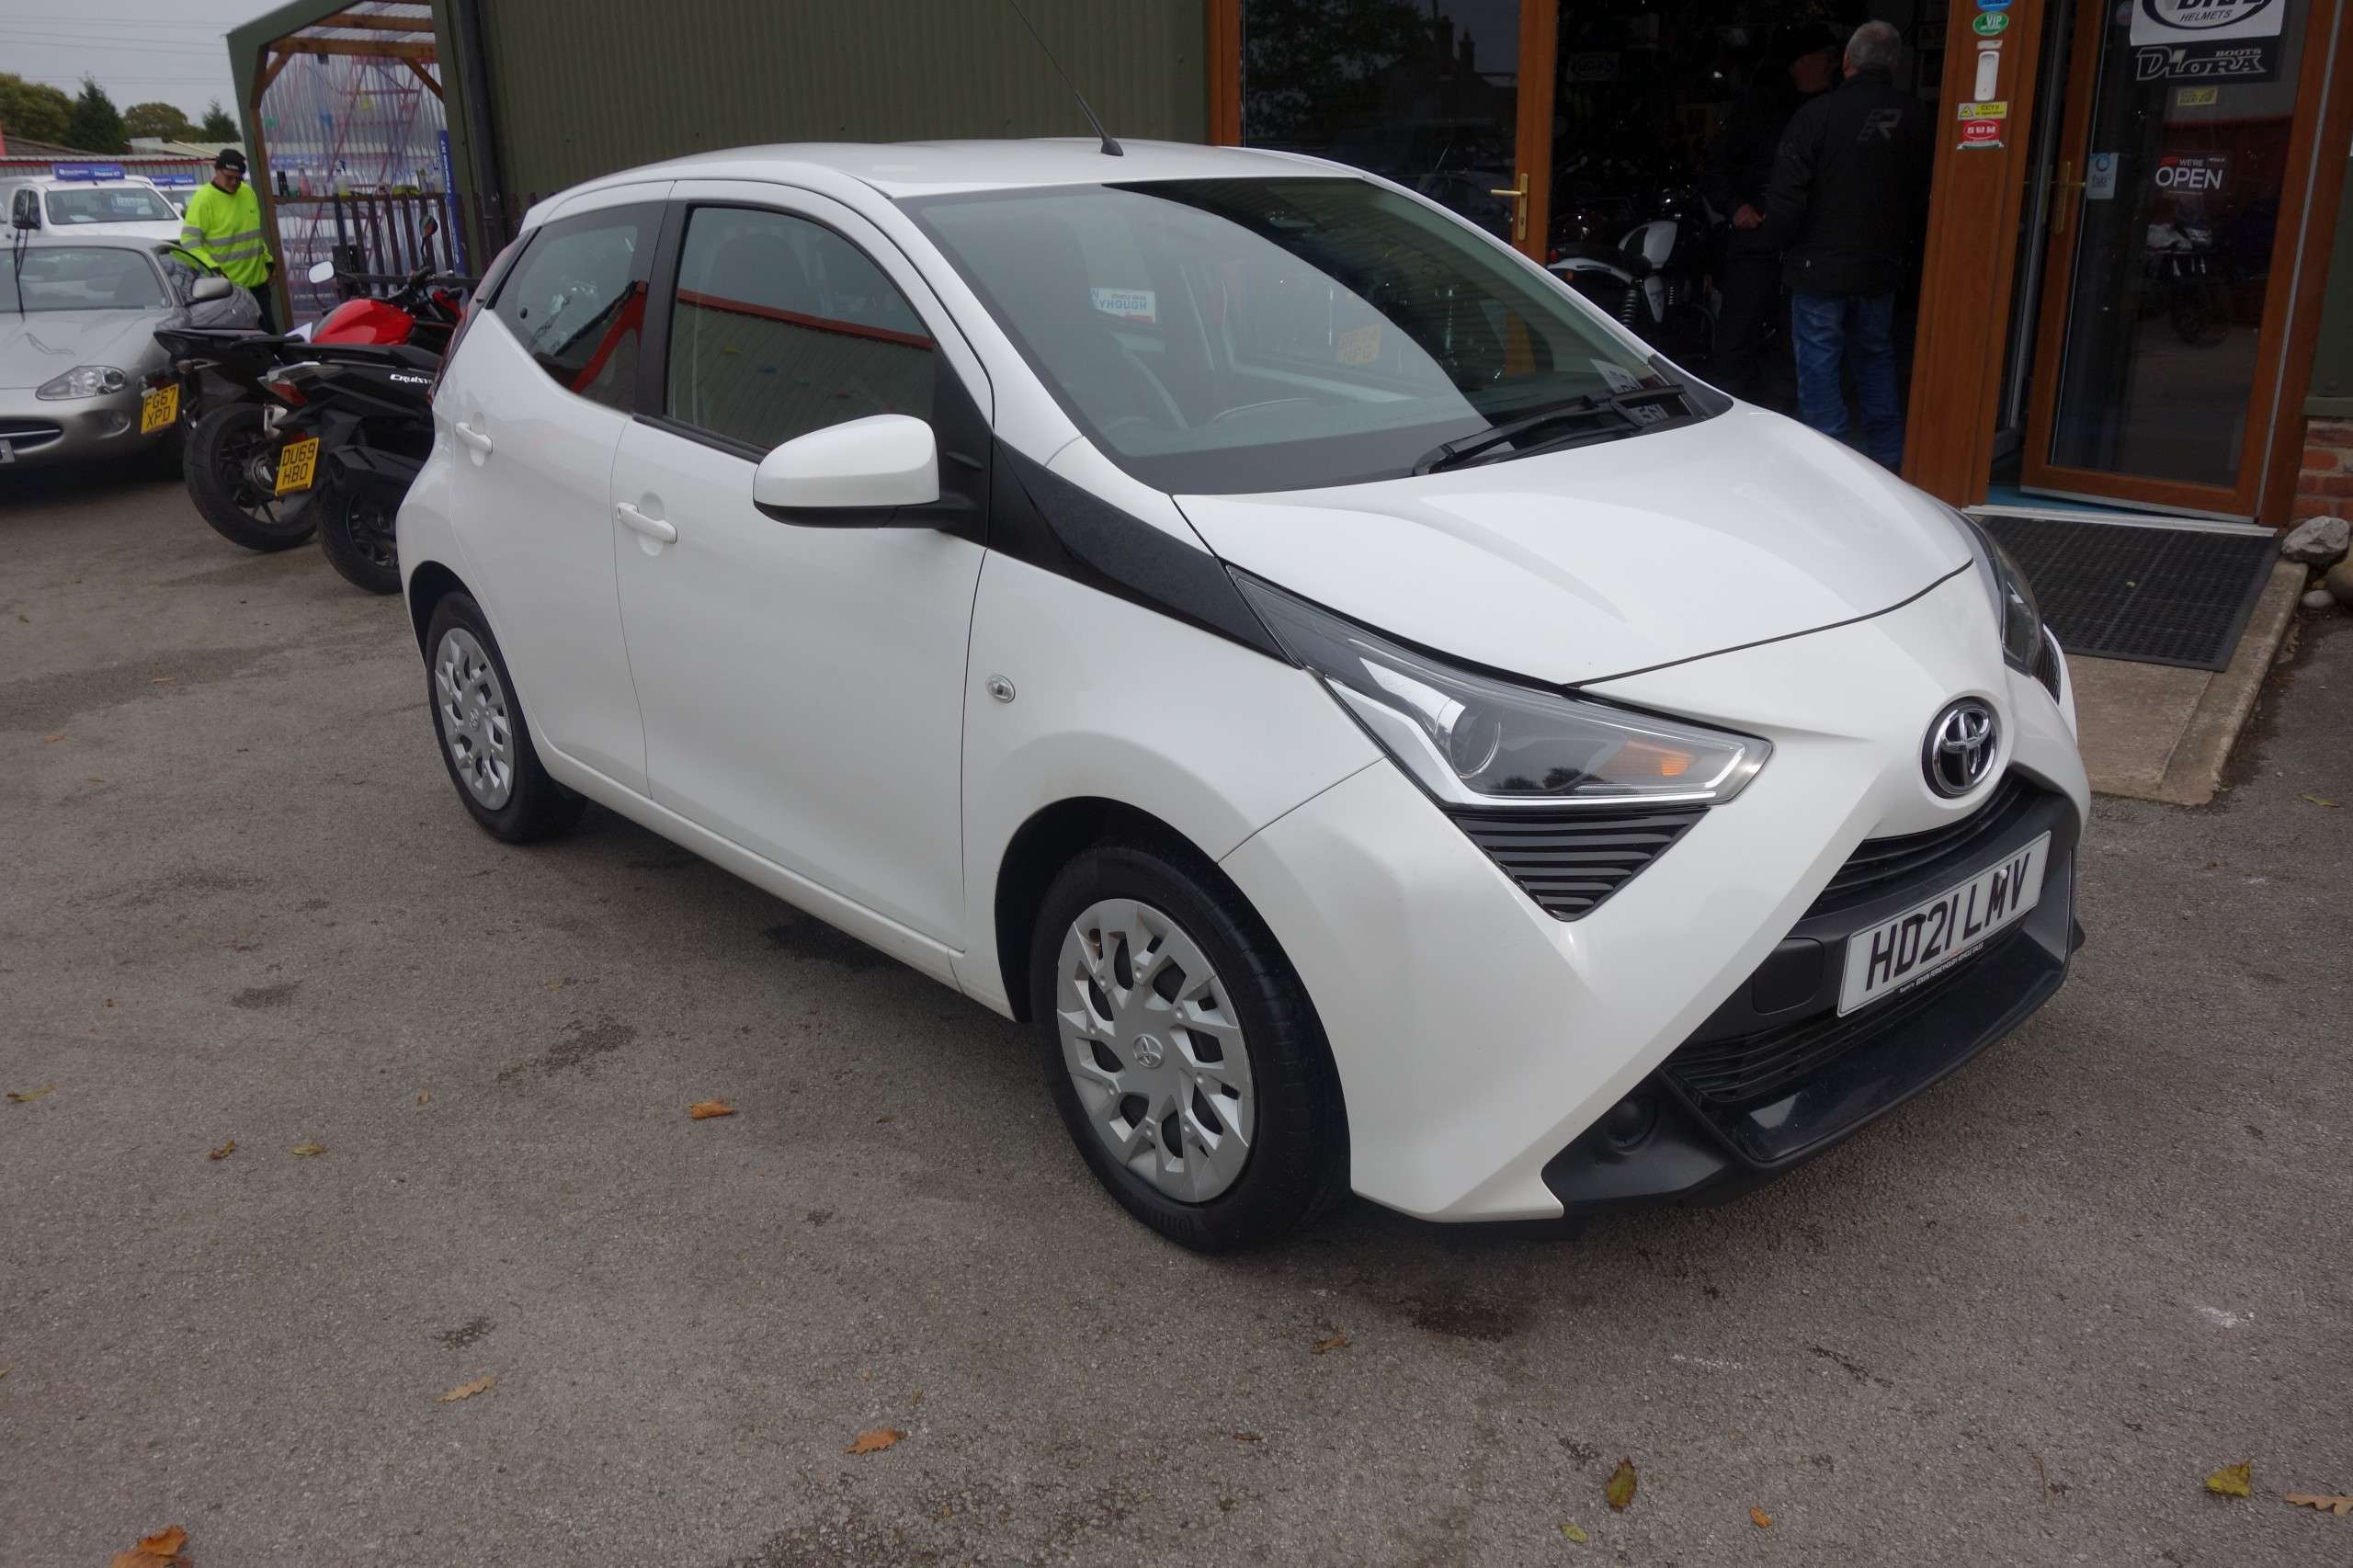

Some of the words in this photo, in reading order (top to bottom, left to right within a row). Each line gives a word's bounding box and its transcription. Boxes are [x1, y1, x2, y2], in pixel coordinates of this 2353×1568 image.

[1986, 15, 2002, 26] VIP
[2180, 9, 2234, 22] HELMETS
[2215, 48, 2262, 58] BOOTS
[2155, 166, 2222, 189] OPEN
[144, 387, 176, 413] FG67
[146, 406, 171, 428] XPD
[282, 442, 315, 466] DU69
[1865, 892, 1960, 992] HD21
[1962, 852, 2031, 941] LMV
